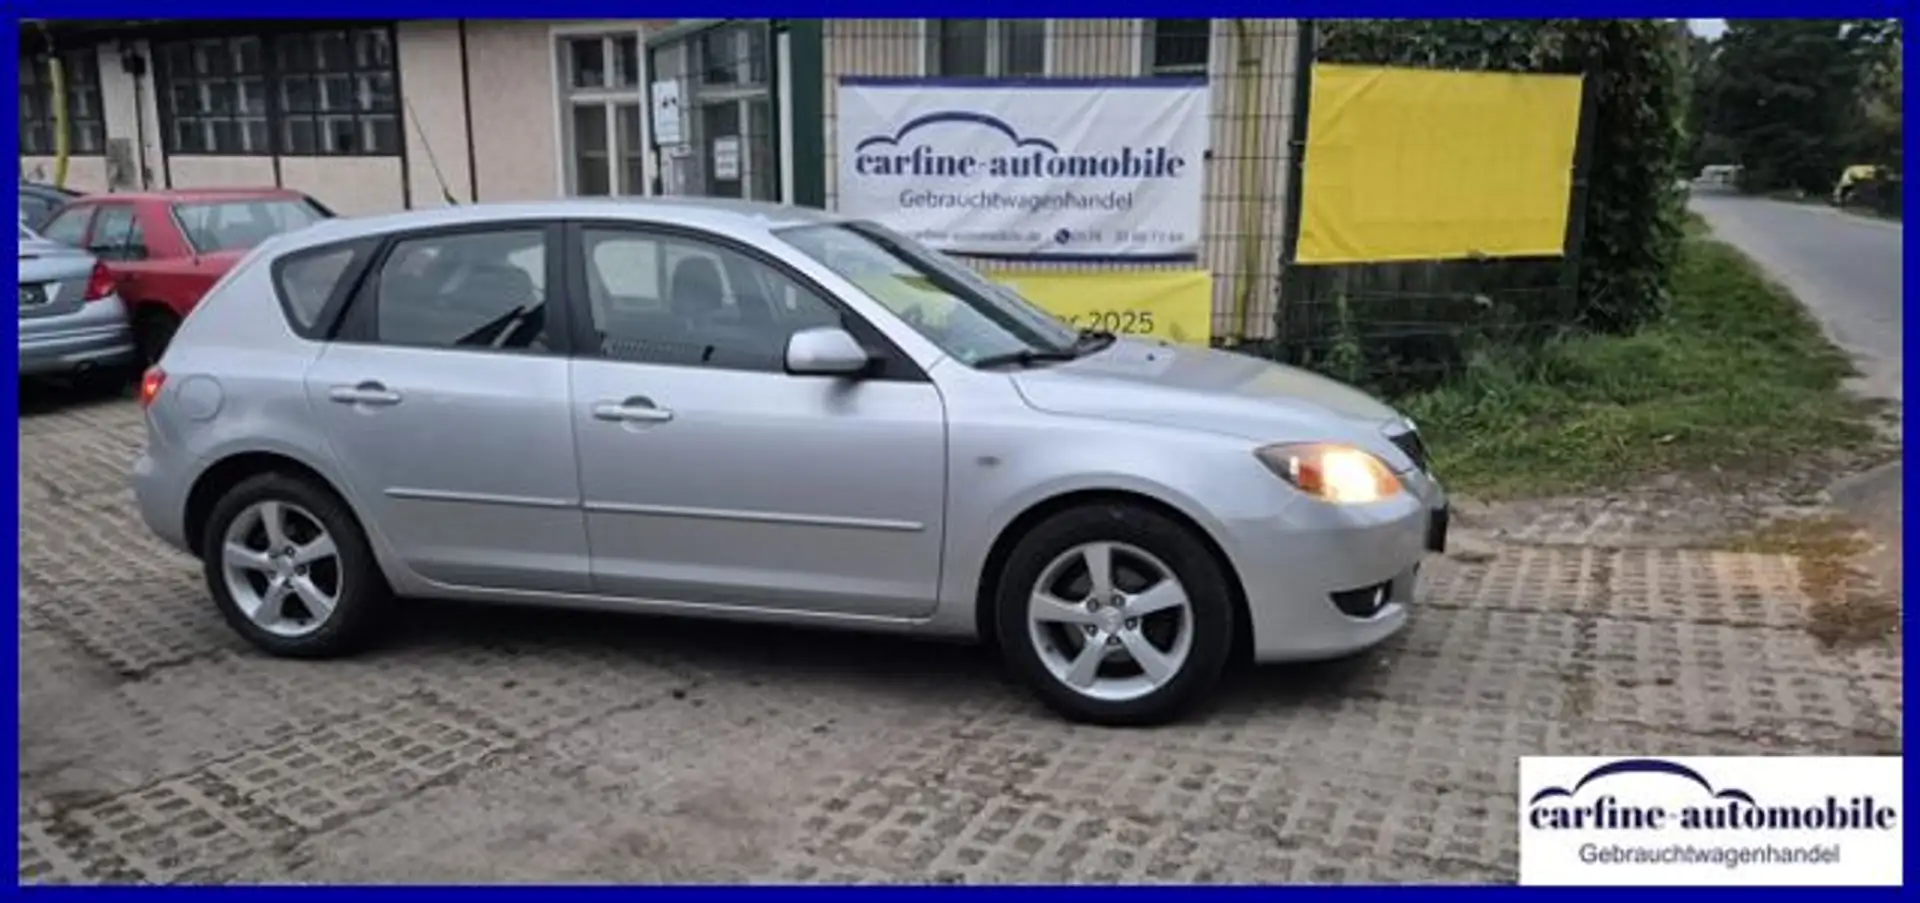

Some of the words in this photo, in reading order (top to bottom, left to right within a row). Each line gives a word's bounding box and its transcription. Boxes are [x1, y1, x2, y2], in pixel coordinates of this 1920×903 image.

[855, 145, 1185, 177] carfine-automobile
[900, 188, 1133, 214] Gebrauchtwagenhandel
[1088, 311, 1154, 334] 2025
